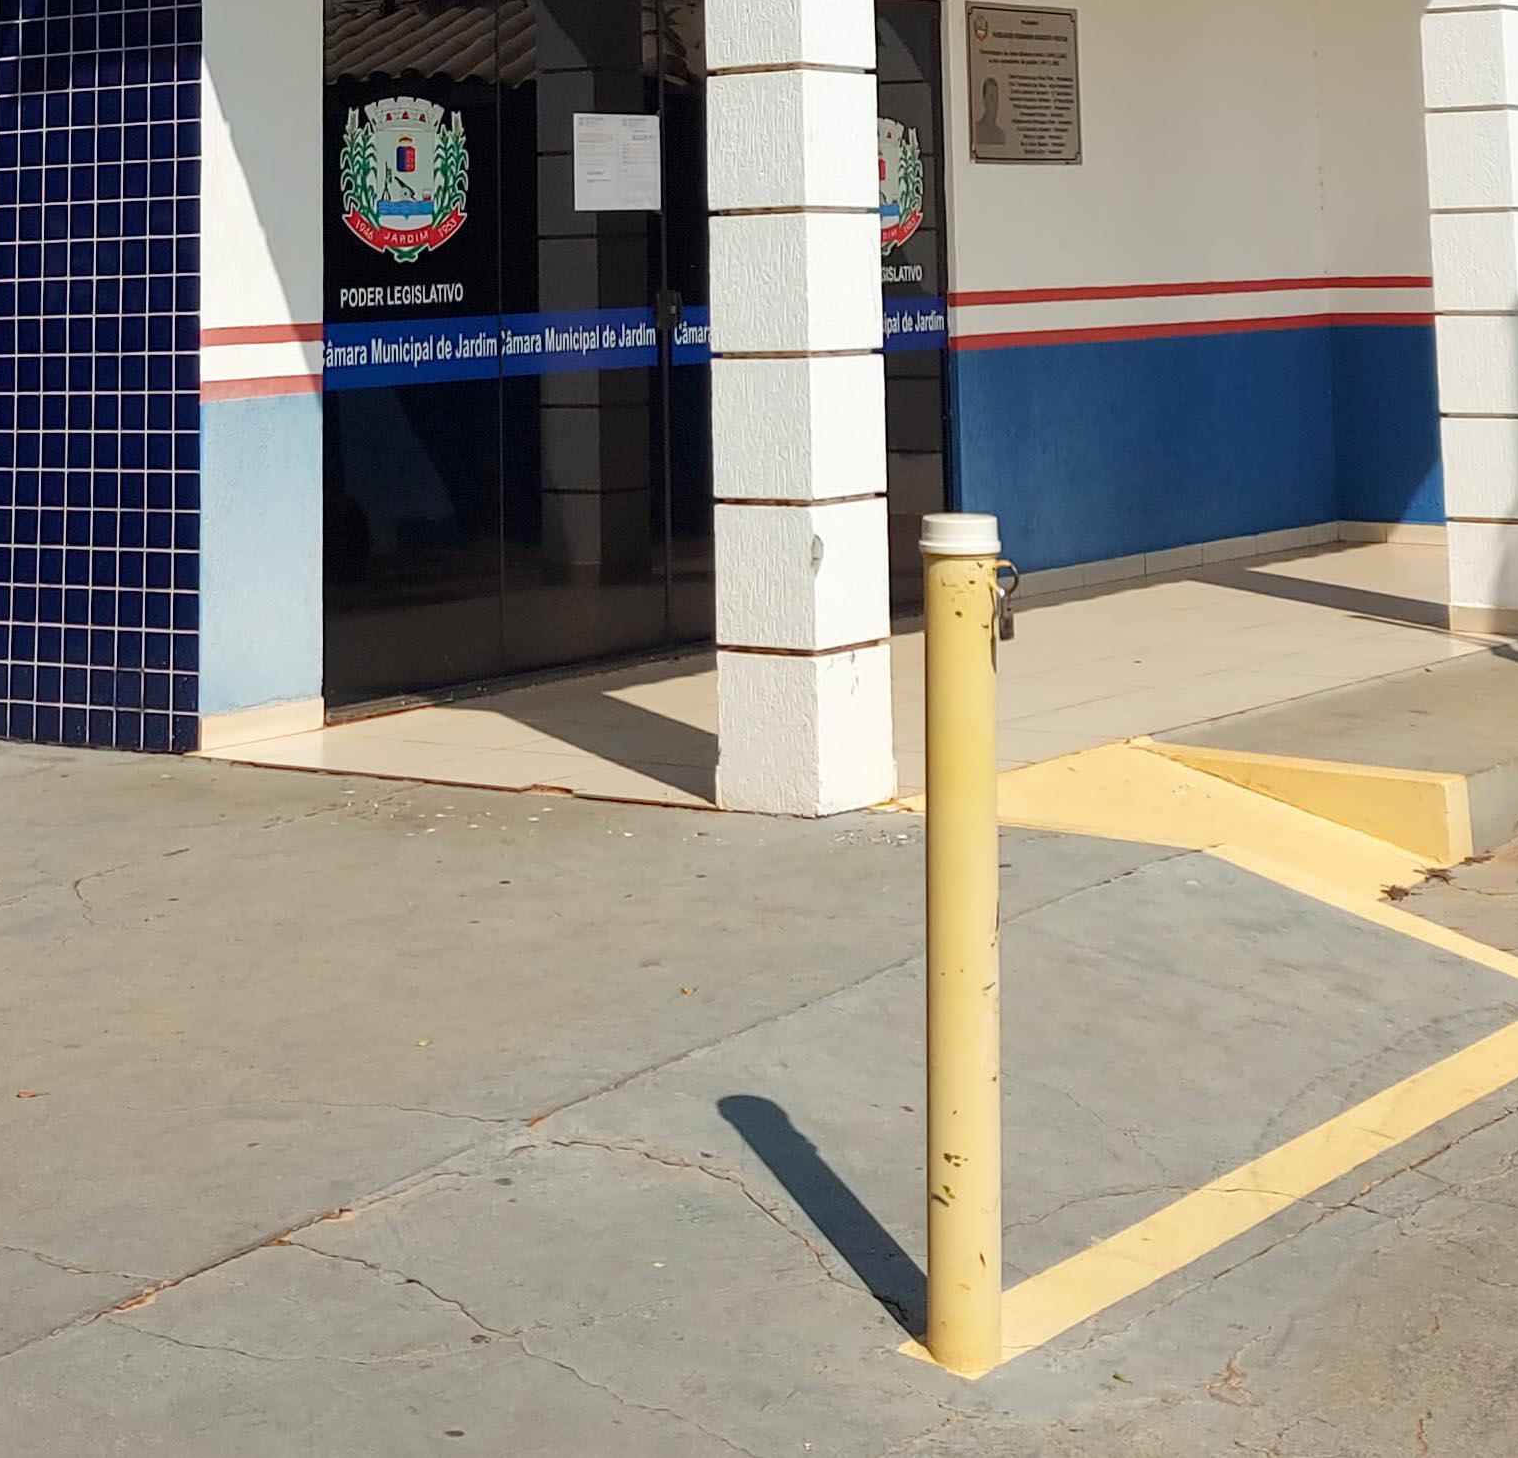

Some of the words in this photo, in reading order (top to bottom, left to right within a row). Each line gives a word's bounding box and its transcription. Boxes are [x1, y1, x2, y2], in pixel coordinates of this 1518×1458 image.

[384, 230, 429, 244] JARDIM
[340, 286, 384, 309] PODER
[386, 283, 464, 306] LEGISLATIVO
[902, 311, 913, 332] de
[323, 339, 367, 368] âmara
[371, 334, 433, 369] Municipal
[436, 333, 452, 360] de
[455, 331, 498, 359] Jardim
[544, 325, 599, 356] Municipal
[602, 324, 616, 349] de
[618, 322, 656, 348] Jardim
